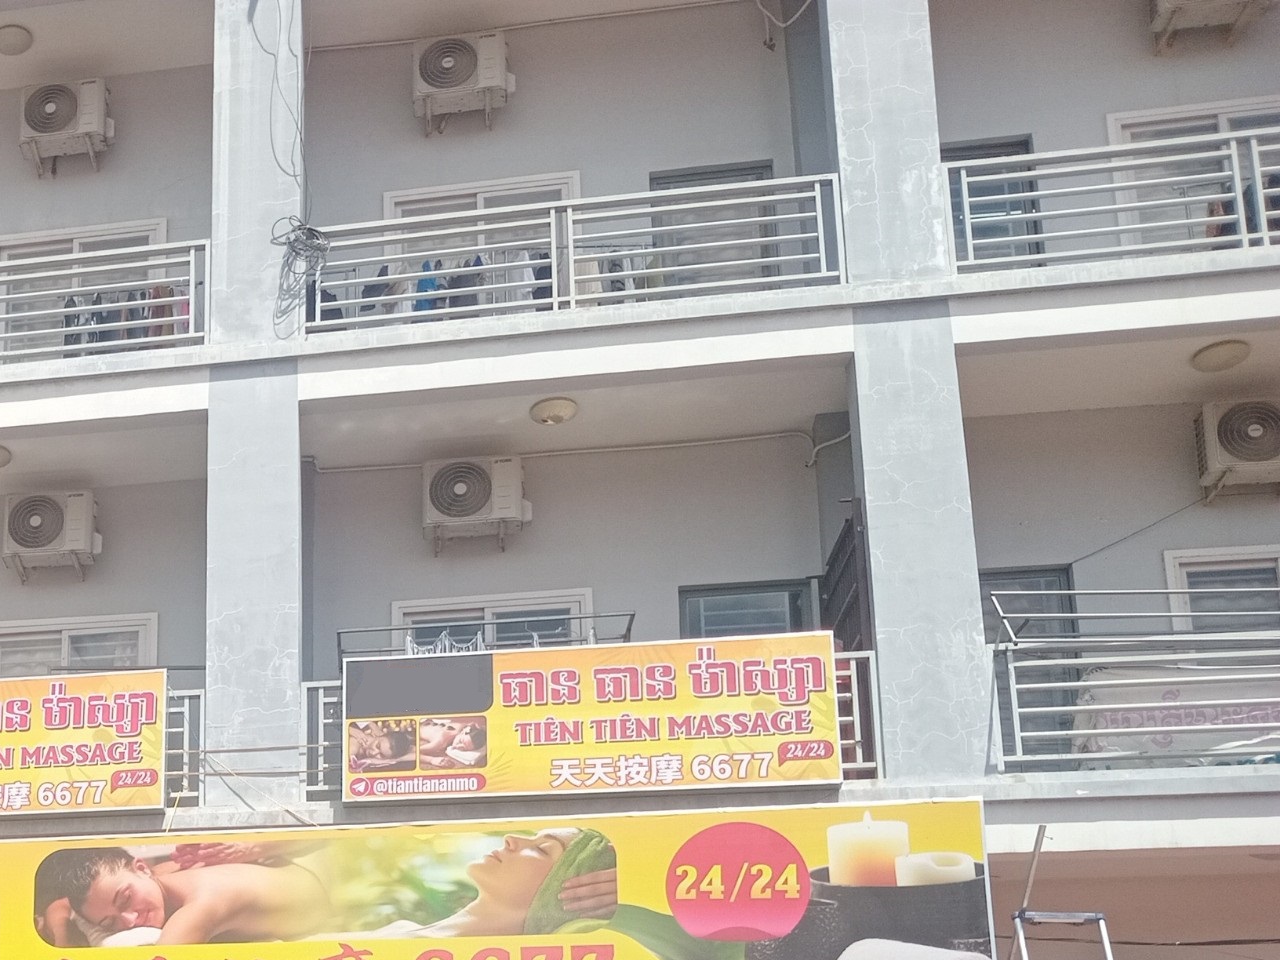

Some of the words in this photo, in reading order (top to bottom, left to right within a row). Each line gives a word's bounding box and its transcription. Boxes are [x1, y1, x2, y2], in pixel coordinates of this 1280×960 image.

[515, 716, 582, 746] TIÊN
[590, 712, 660, 743] TIÊN
[667, 710, 813, 740] MASSAGE
[21, 740, 143, 768] MASSAGE
[786, 741, 826, 758] 24/24
[117, 771, 152, 786] 24/24
[550, 756, 684, 789] 天天按摩
[691, 752, 773, 781] 6677
[37, 780, 106, 806] 6677
[372, 776, 478, 796] @tiantiananmo
[675, 860, 801, 903] 24/24
